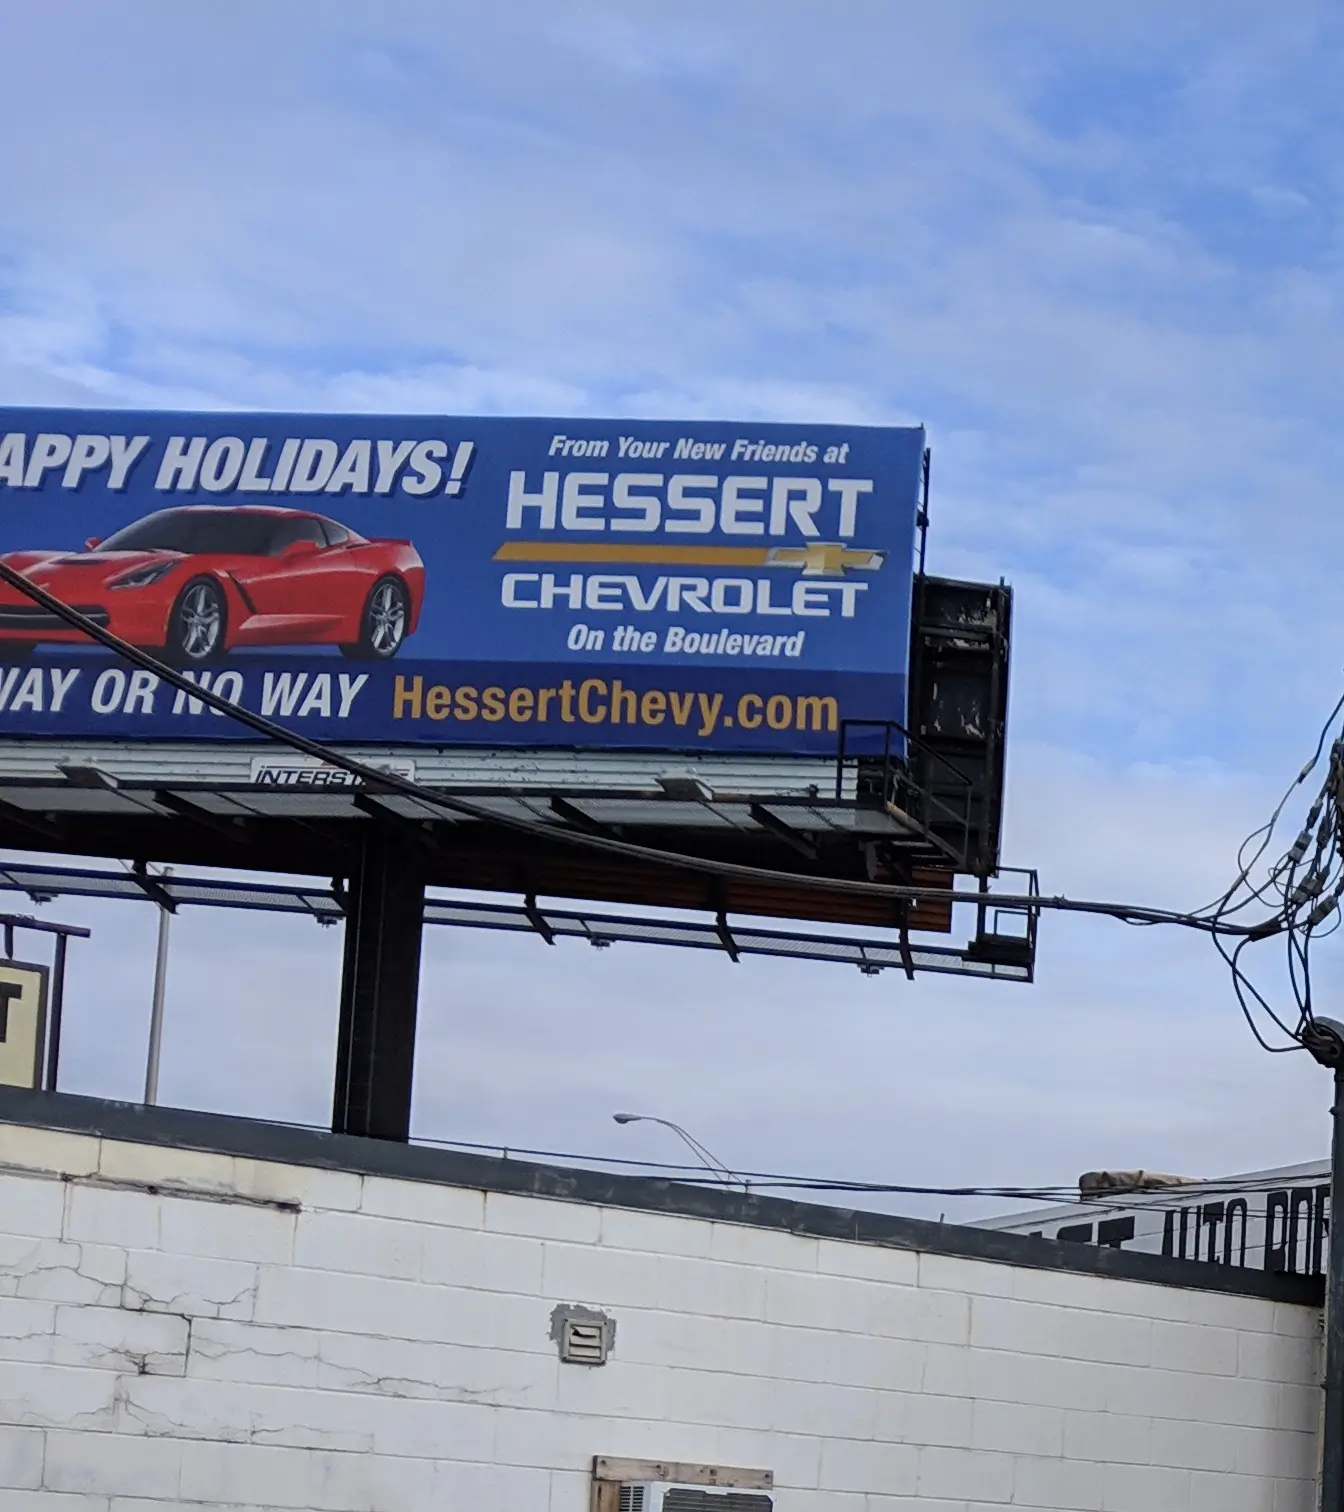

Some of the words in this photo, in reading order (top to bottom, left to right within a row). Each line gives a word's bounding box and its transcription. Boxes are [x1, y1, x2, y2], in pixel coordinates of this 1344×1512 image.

[155, 436, 475, 496] HOLIDAYS!
[548, 435, 608, 458] From
[618, 437, 669, 460] Your
[673, 438, 726, 461] New
[731, 439, 817, 463] Friends
[823, 443, 850, 464] at
[506, 471, 873, 537] HESSERT
[501, 573, 868, 618] CHEVROLET
[568, 624, 605, 651] On
[612, 626, 657, 652] the
[664, 628, 805, 657] Boulevard
[90, 668, 169, 717] OR
[172, 671, 244, 717] NO
[261, 672, 369, 718] WAY
[393, 675, 838, 736] HessertChevy.com
